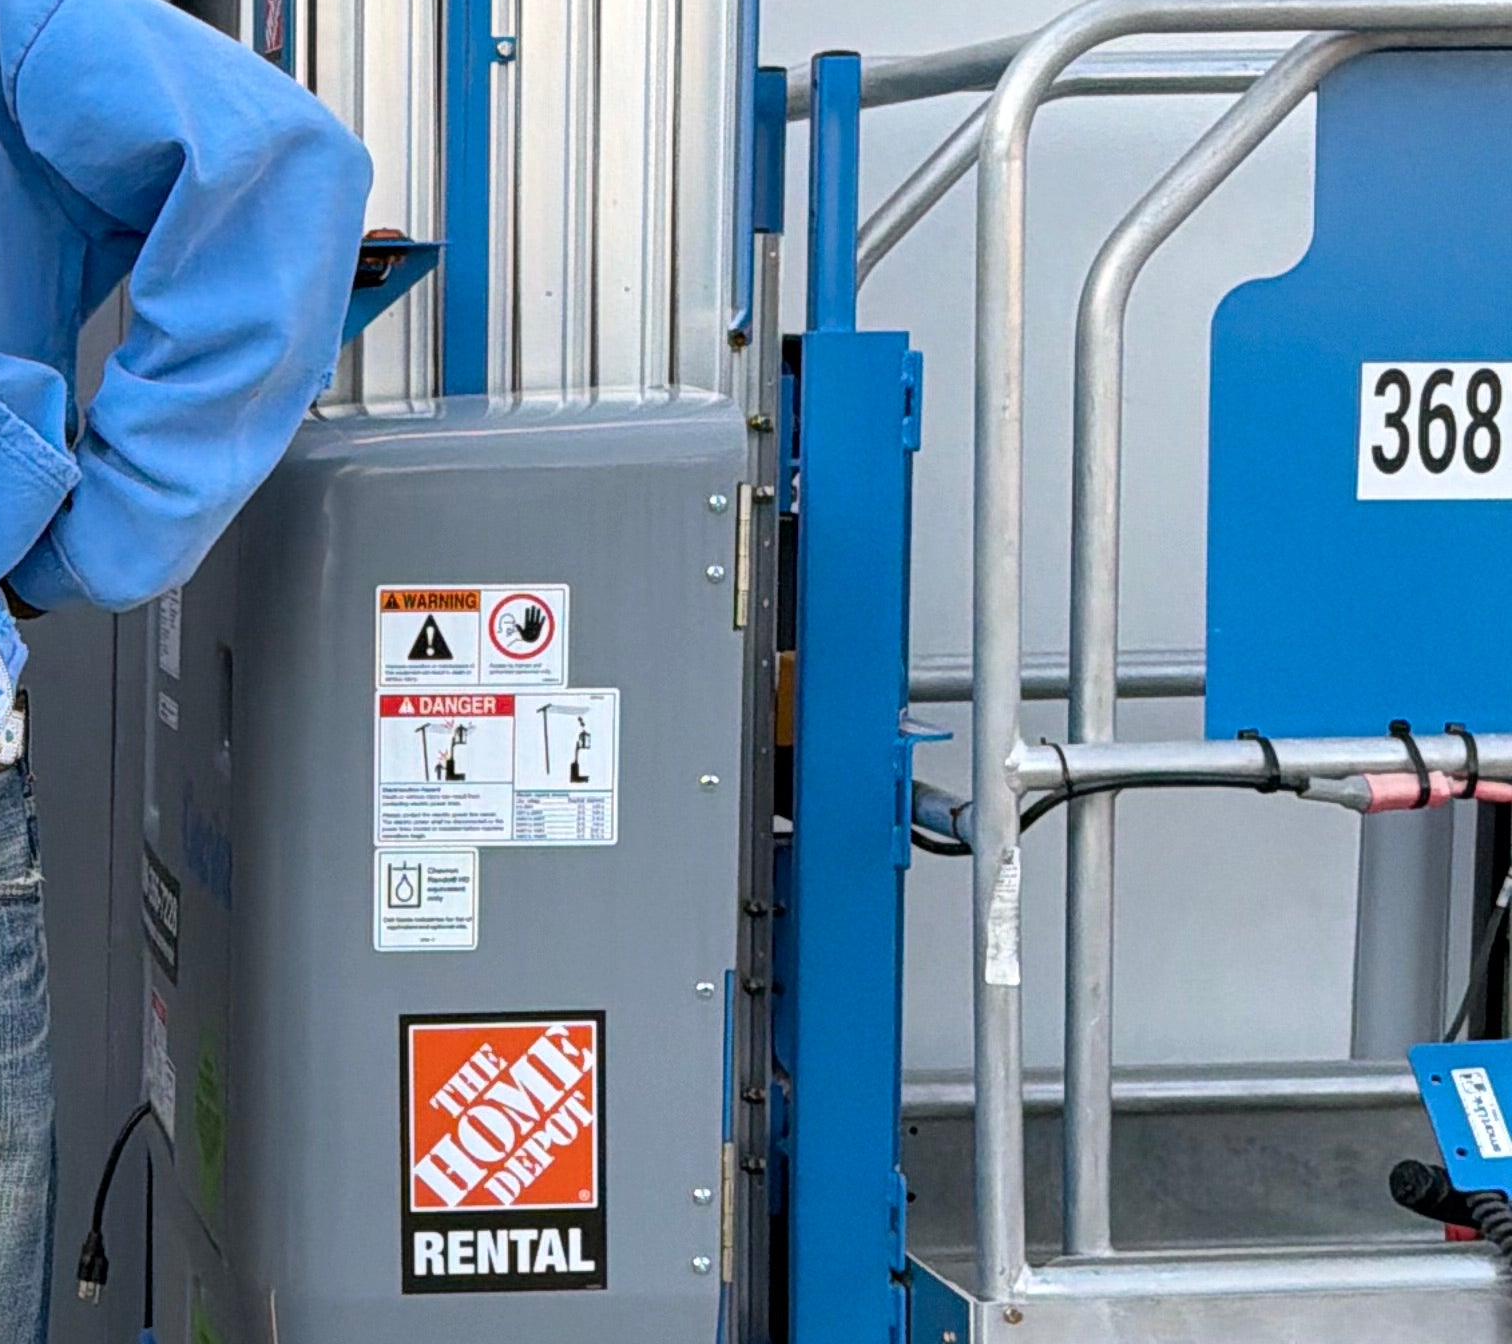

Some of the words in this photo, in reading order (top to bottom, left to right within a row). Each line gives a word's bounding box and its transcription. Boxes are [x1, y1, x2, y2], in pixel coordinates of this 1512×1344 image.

[1371, 368, 1502, 475] 368
[403, 592, 477, 609] WARNING
[419, 696, 497, 714] DANGER
[414, 1025, 594, 1207] HOME
[429, 1042, 508, 1119] THE
[484, 1090, 594, 1206] DEPOT
[413, 1227, 596, 1276] RENTAL
